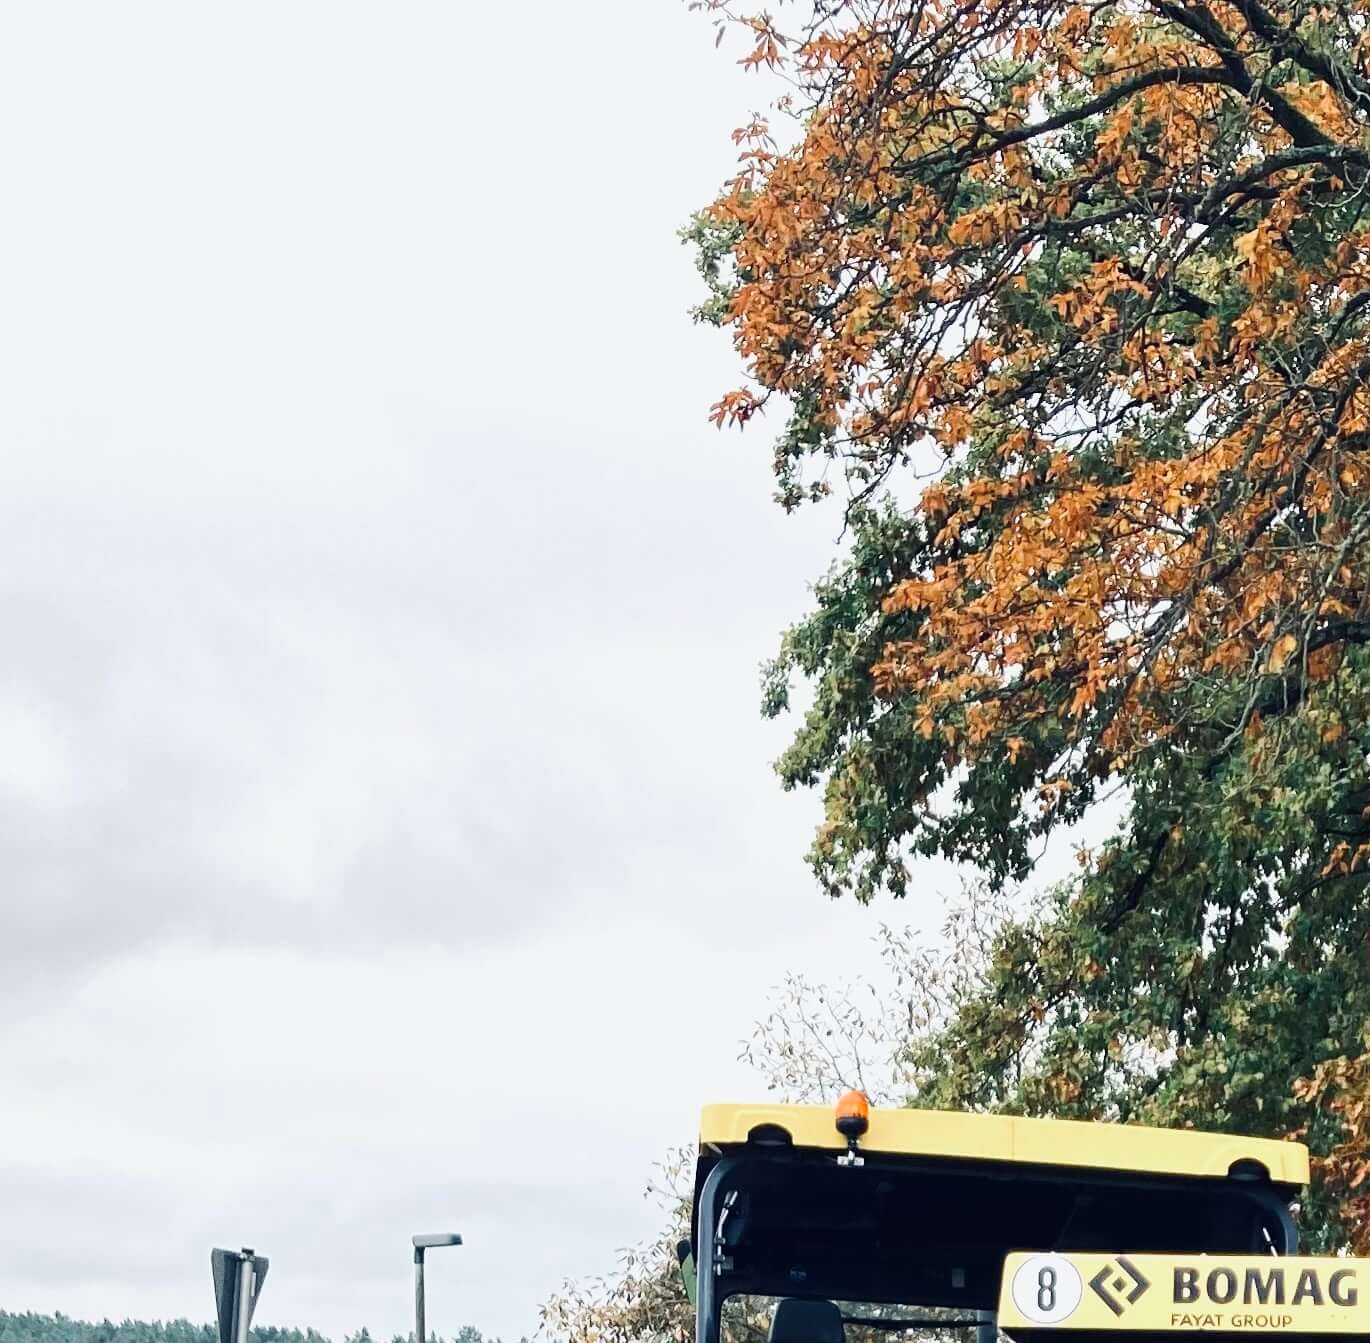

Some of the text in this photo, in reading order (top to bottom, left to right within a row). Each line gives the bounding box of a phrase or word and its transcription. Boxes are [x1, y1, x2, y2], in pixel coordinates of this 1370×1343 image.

[1037, 1266, 1057, 1311] 8
[1173, 1267, 1358, 1306] BOMAG
[1171, 1313, 1292, 1328] FAYAT GROUP
